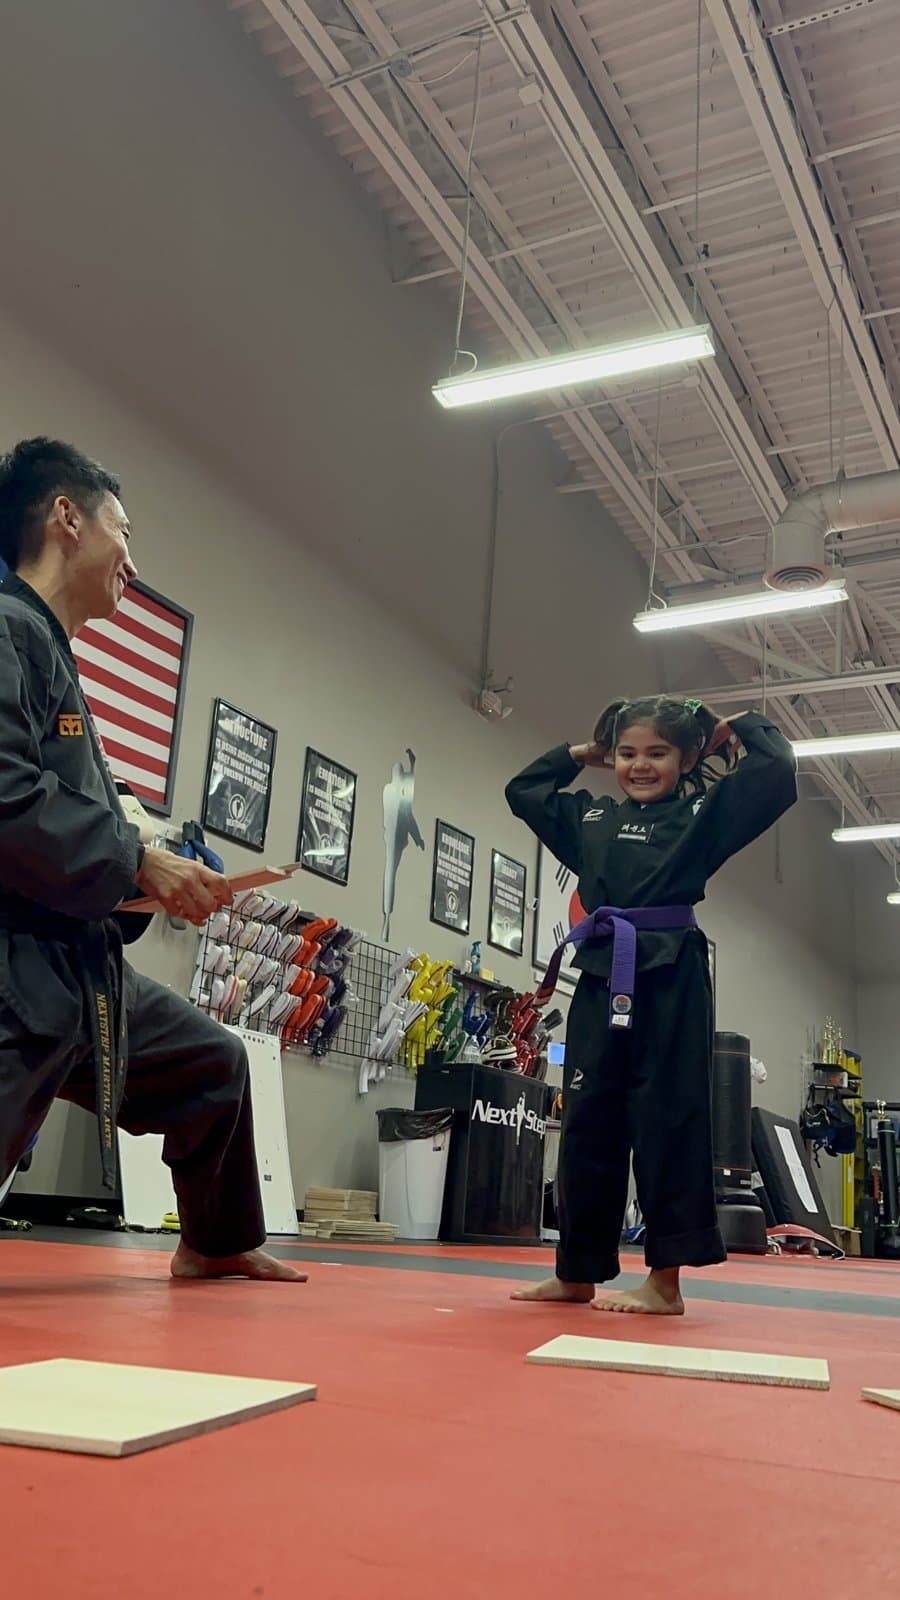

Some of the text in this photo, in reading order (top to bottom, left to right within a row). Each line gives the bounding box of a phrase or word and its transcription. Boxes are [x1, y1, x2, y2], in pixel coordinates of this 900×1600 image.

[96, 992, 110, 1054] NEXTSTEP
[103, 1055, 112, 1112] MARTIAL
[471, 1099, 548, 1140] Next Step
